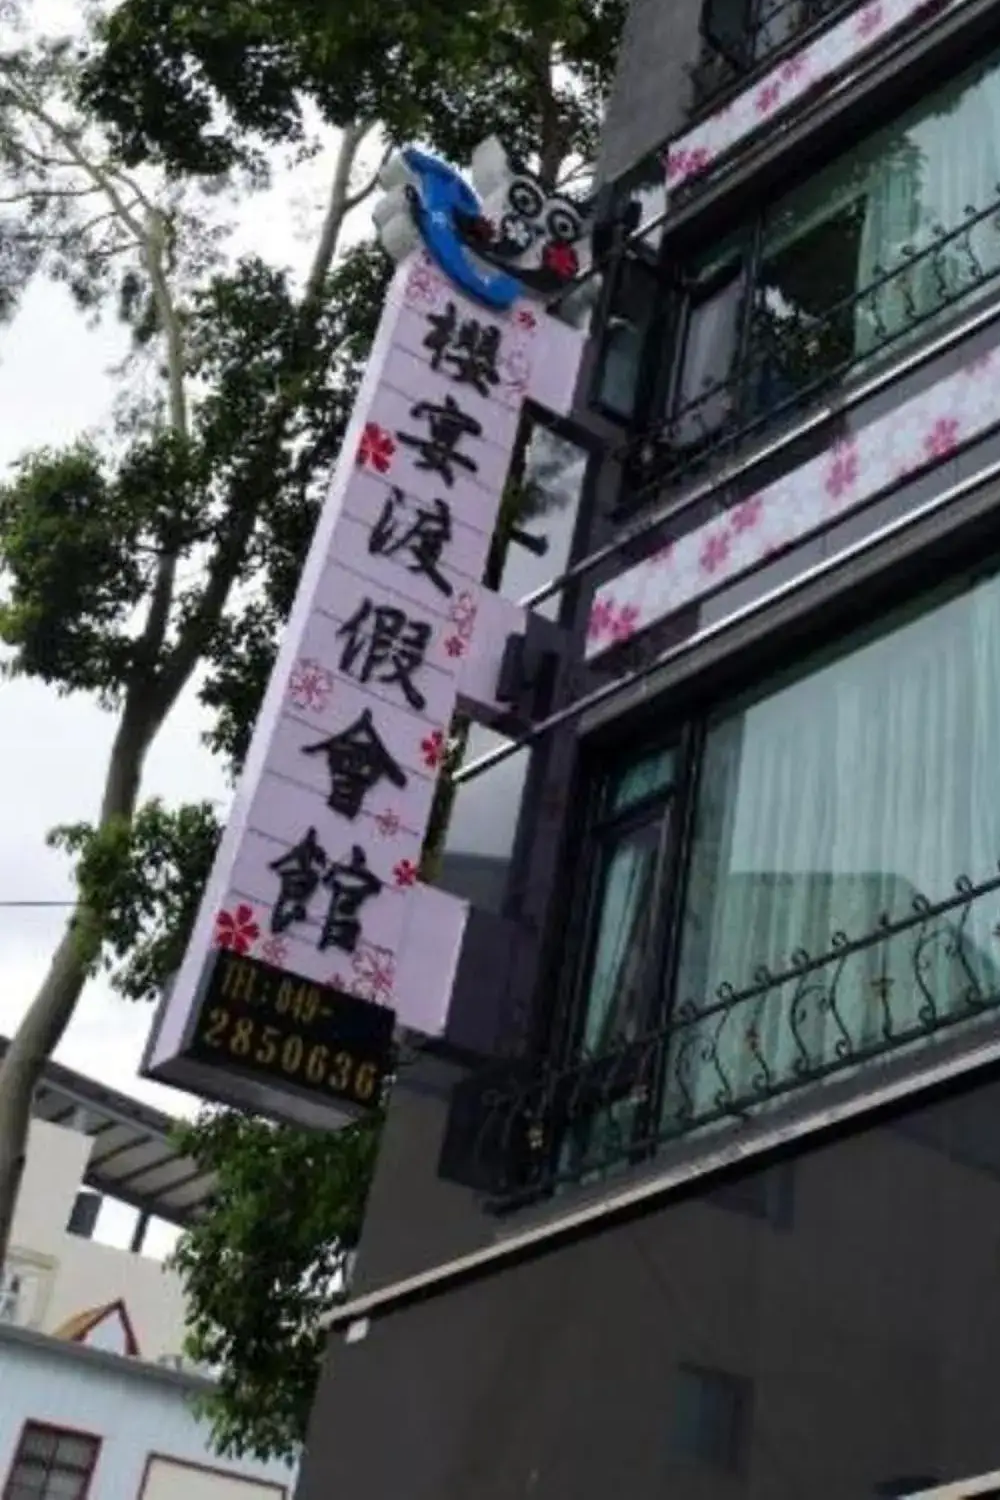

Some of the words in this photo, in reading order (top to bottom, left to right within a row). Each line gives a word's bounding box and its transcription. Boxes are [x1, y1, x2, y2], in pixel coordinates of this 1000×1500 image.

[268, 302, 501, 954] 櫻宴渡假會館
[203, 1006, 378, 1100] 2850636
